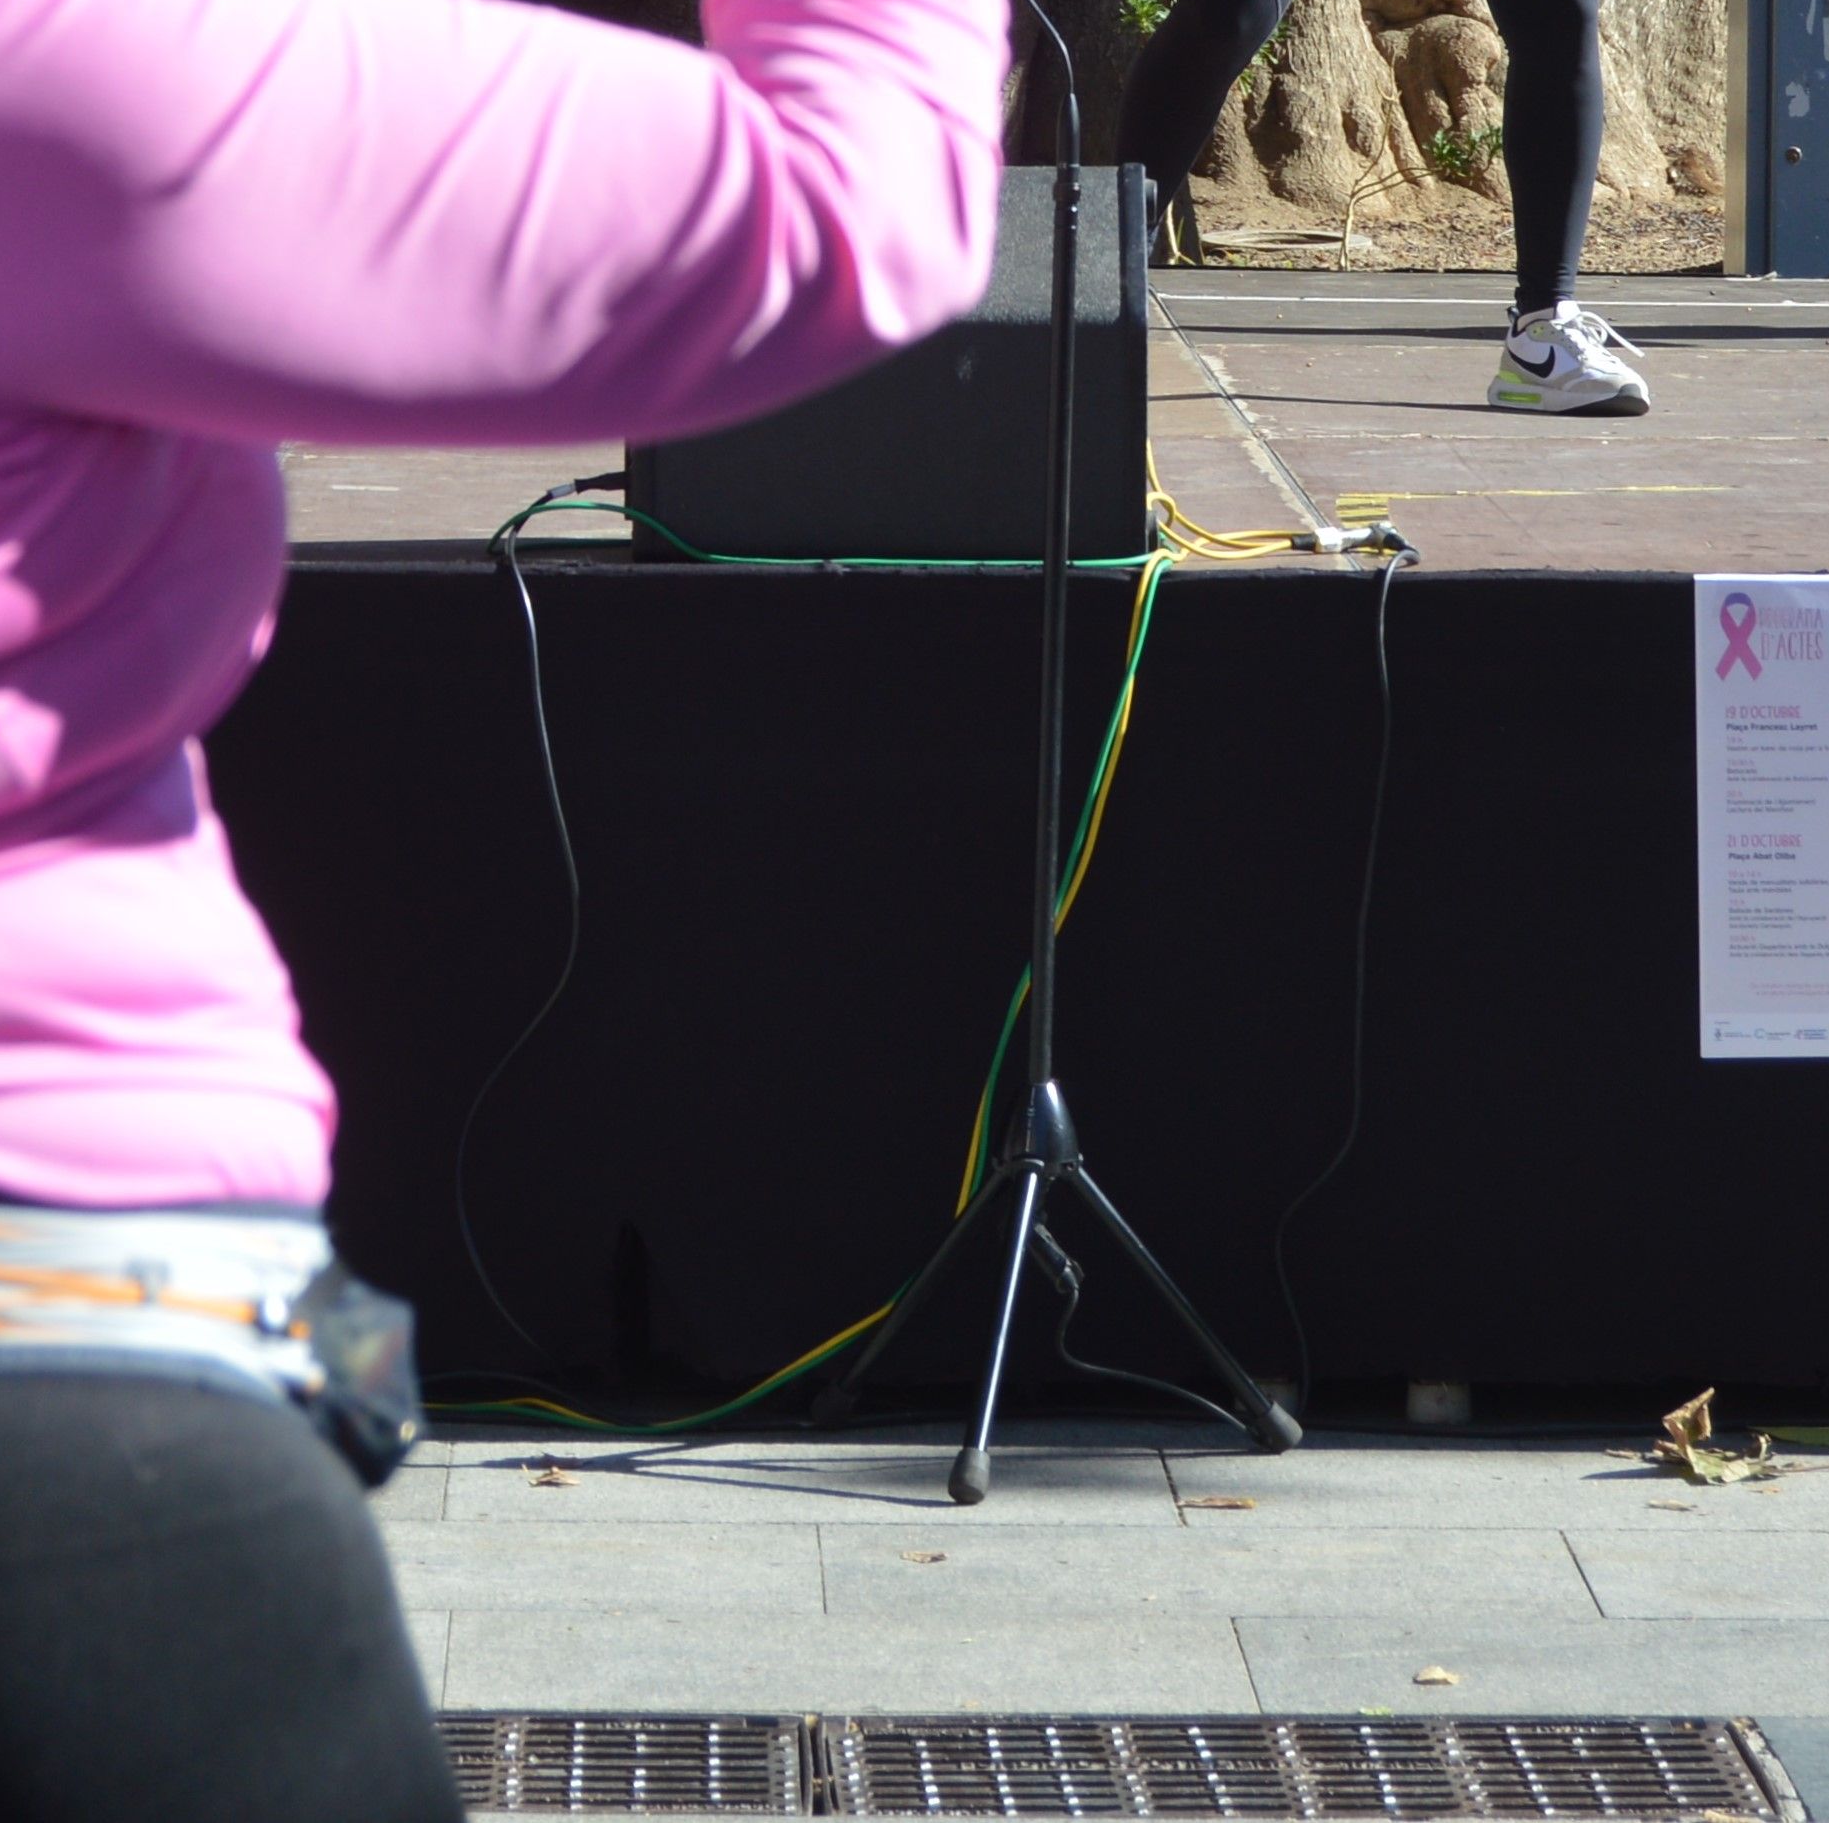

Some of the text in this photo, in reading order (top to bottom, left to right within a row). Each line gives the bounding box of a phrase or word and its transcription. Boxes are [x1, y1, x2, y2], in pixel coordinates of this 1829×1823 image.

[1760, 631, 1823, 660] D'ACTES
[1740, 705, 1801, 718] D'OCTUBRE
[1726, 722, 1748, 731] Plaça
[1740, 834, 1802, 847] D'OCTUBRE
[1728, 852, 1750, 861] Plaça
